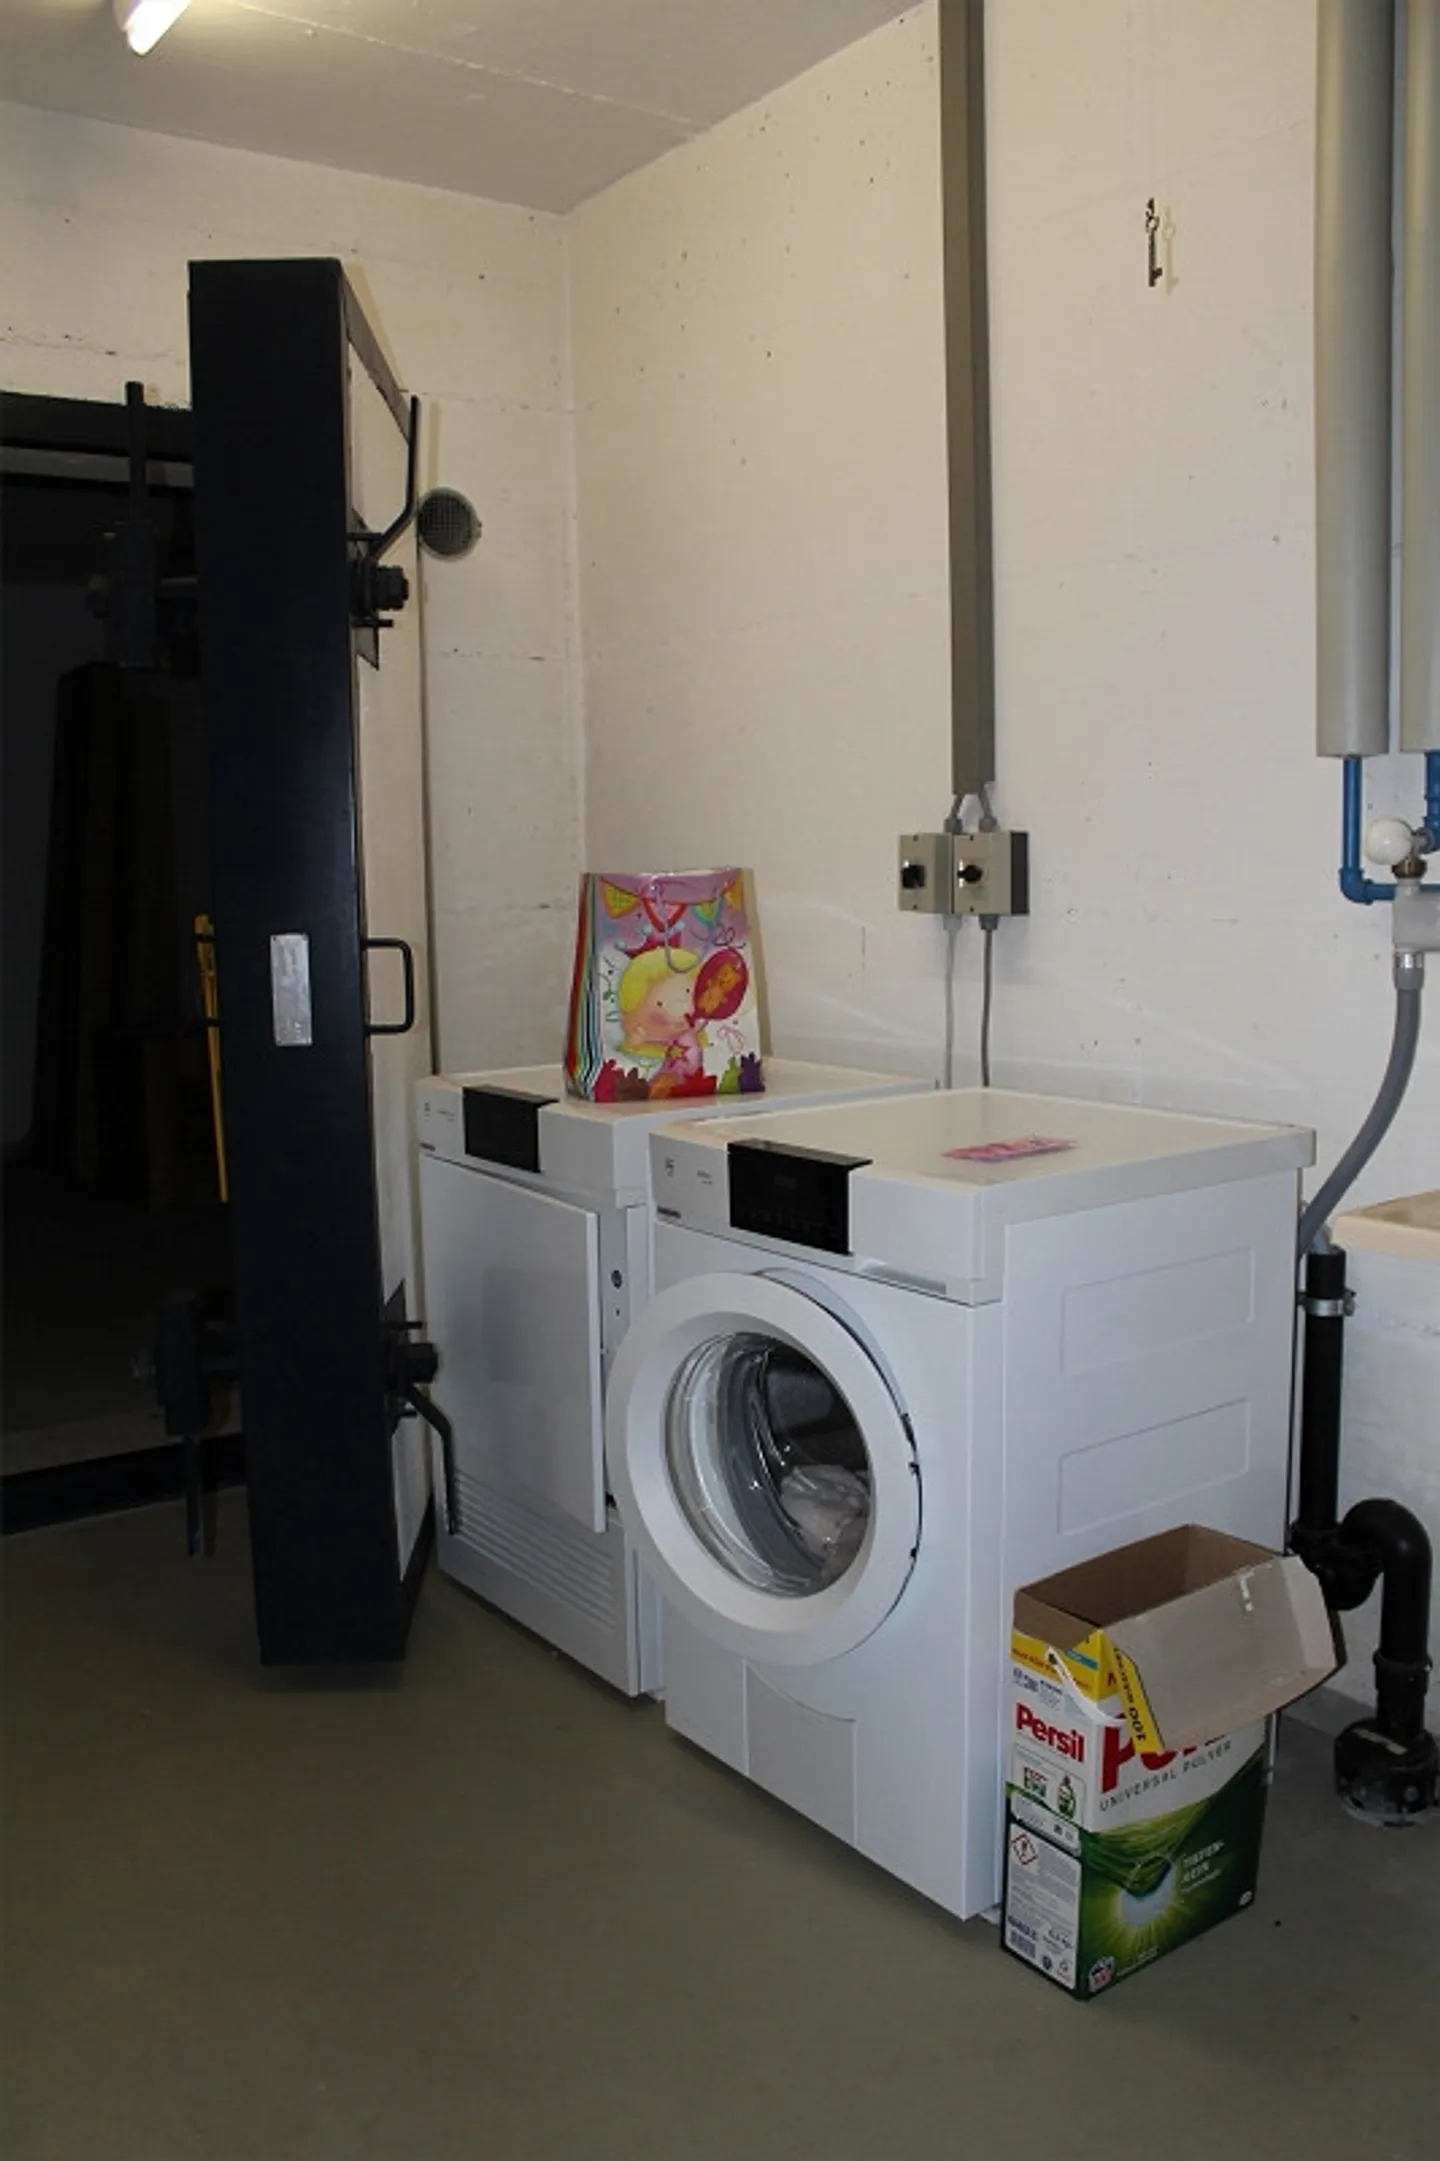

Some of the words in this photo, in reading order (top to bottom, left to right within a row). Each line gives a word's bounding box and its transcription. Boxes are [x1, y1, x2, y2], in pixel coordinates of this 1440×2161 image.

[1016, 1703, 1084, 1762] Persil
[1099, 1769, 1177, 1811] UNIVERSAL
[1182, 1740, 1231, 1773] PULVER
